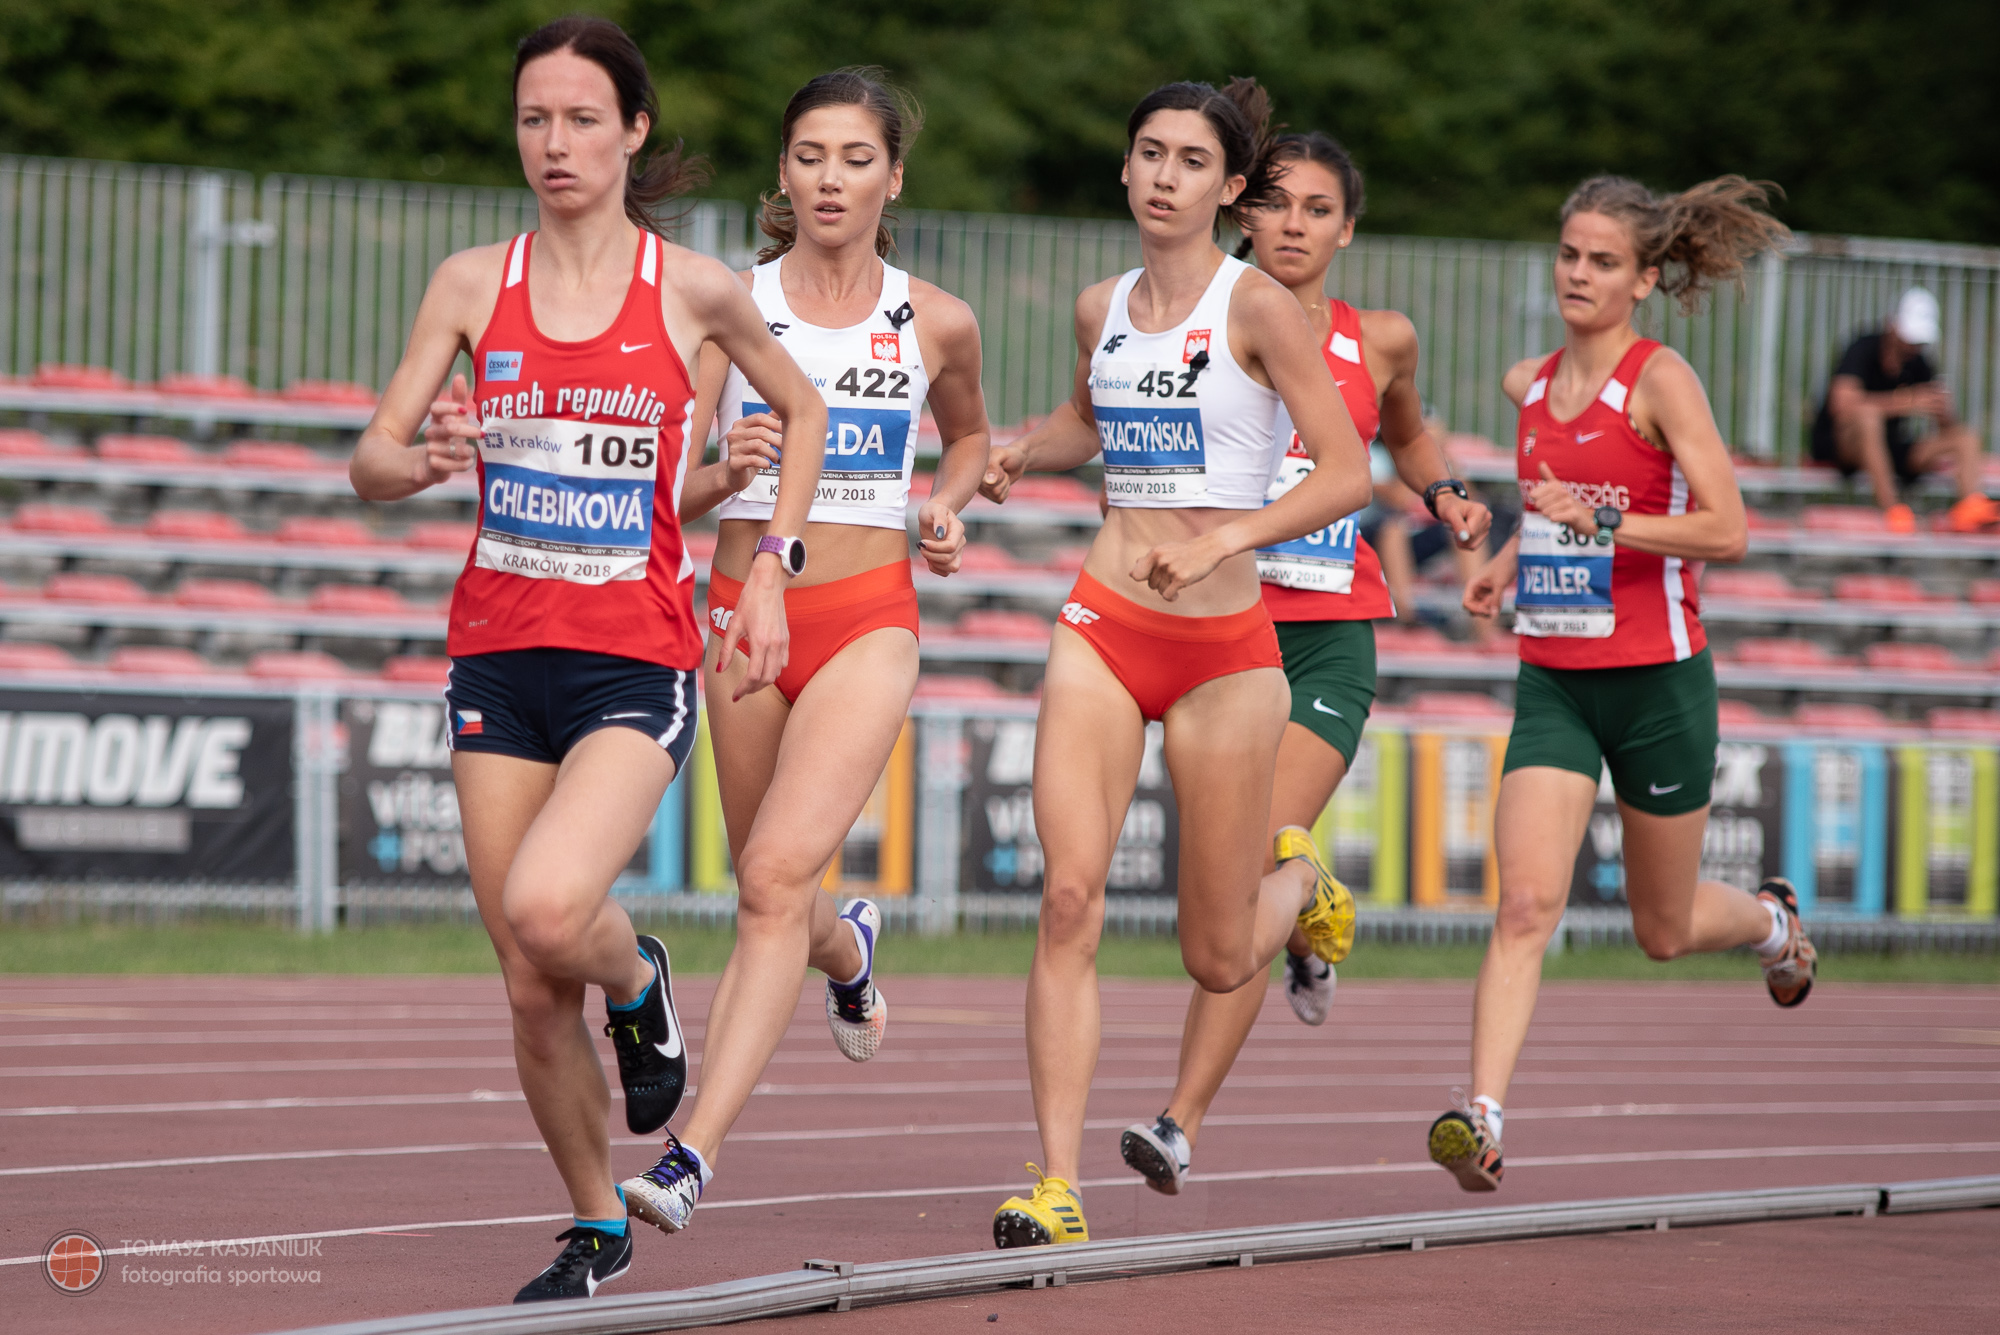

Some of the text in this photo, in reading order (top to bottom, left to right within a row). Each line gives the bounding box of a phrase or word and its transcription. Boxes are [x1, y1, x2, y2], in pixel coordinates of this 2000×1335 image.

[835, 367, 911, 399] 422
[1137, 370, 1197, 398] 452
[481, 381, 666, 426] czech republic
[509, 433, 656, 469] Kraków 105
[842, 488, 876, 501] 2018
[1146, 482, 1177, 494] 2018
[489, 478, 646, 531] CHLEBIKOVÁ
[502, 552, 612, 578] KRAKÓW 2018
[1296, 570, 1327, 584] 2018
